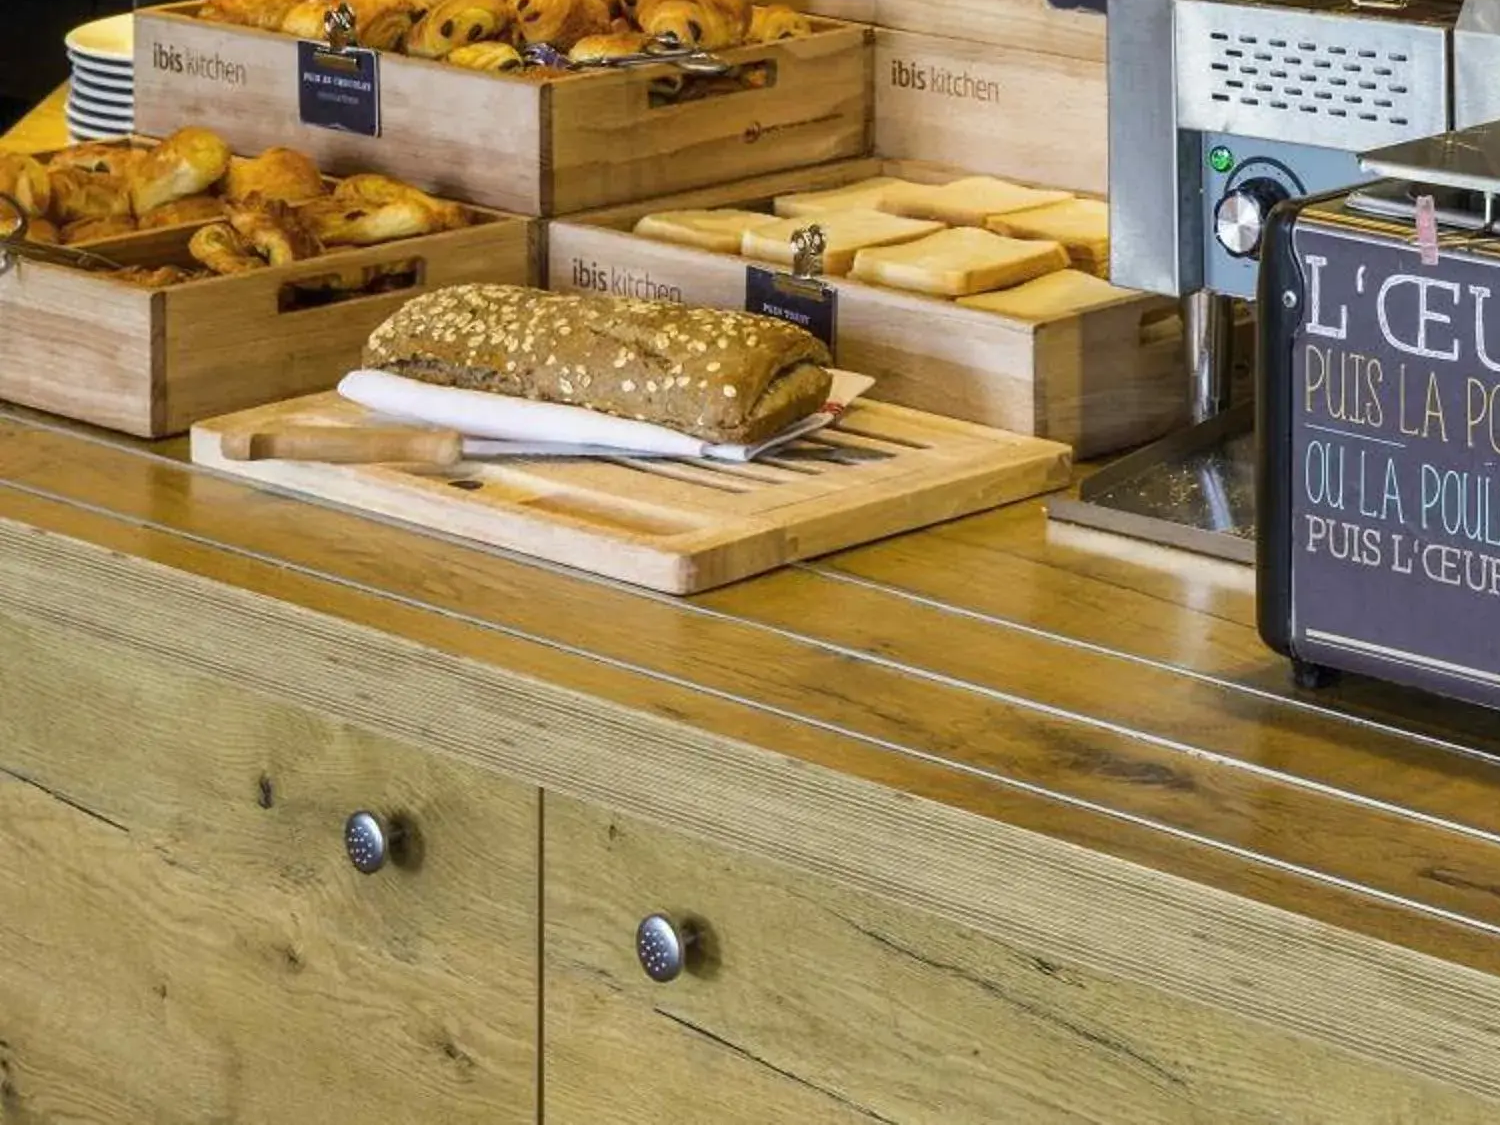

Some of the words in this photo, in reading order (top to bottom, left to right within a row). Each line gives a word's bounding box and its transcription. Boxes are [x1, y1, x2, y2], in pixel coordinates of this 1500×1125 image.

[152, 42, 183, 74] ibis
[185, 46, 248, 86] kitchen
[890, 59, 926, 91] ibis
[929, 66, 1000, 104] kitchen
[571, 258, 607, 292] ibis
[609, 265, 683, 304] kitchen
[1305, 344, 1384, 427] PUIS
[1400, 363, 1449, 442] LA
[1305, 440, 1345, 510] OU
[1360, 450, 1405, 524] LA
[1304, 514, 1381, 567] PUIS
